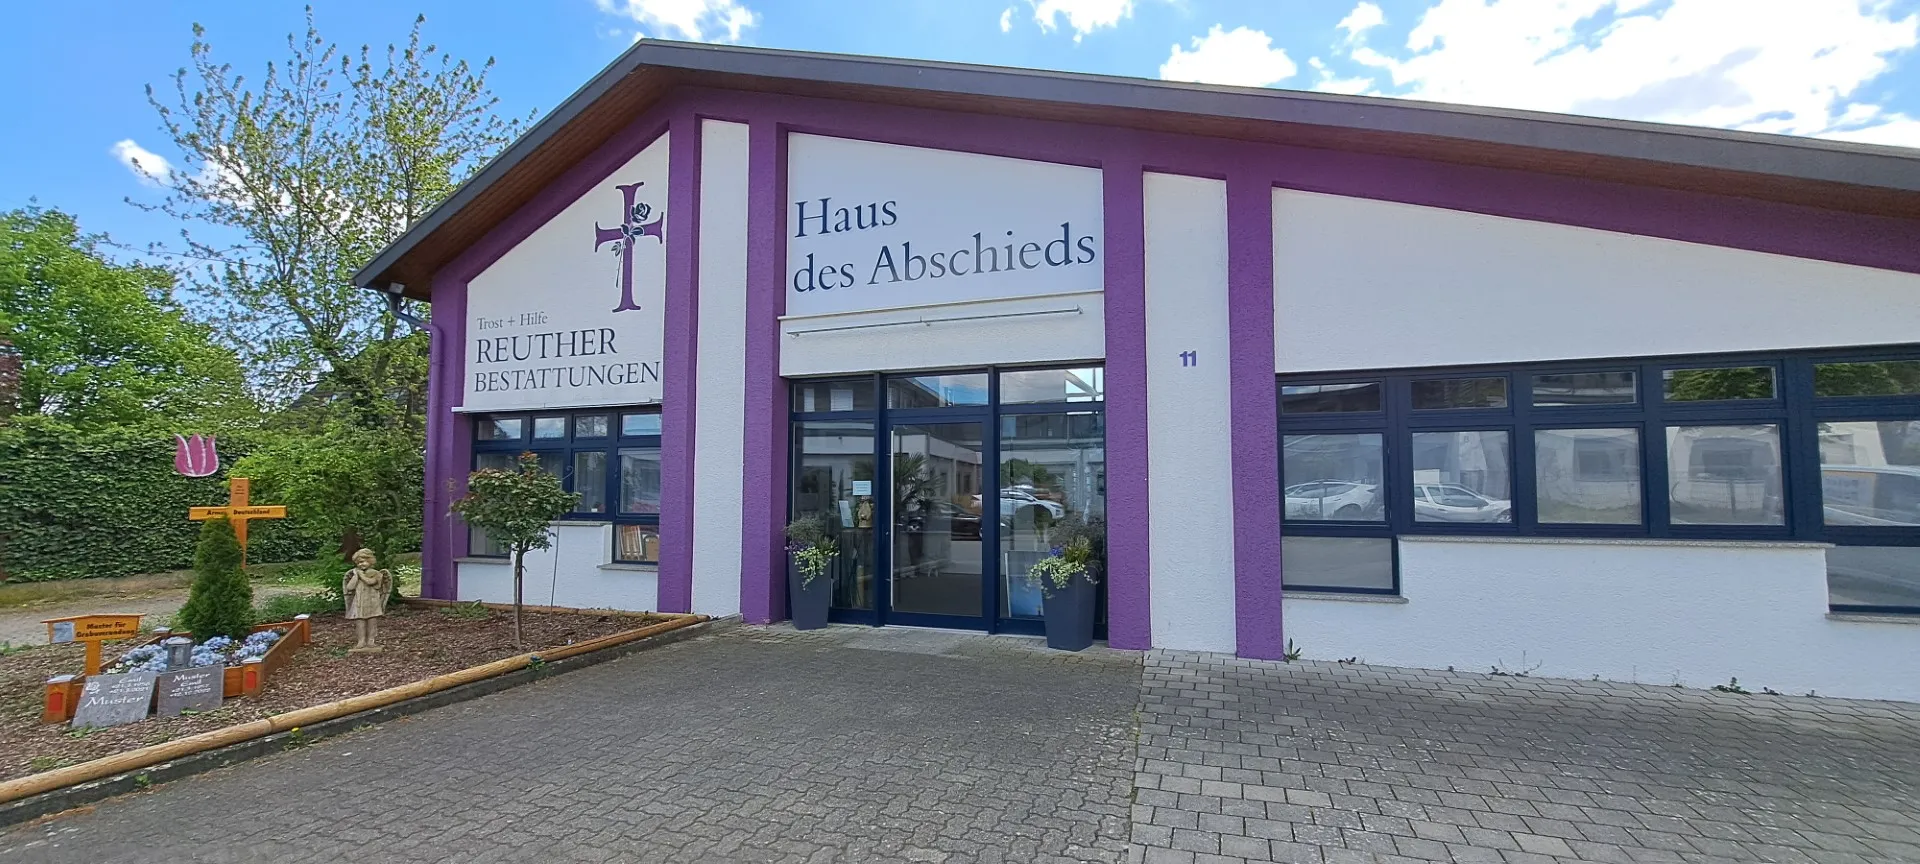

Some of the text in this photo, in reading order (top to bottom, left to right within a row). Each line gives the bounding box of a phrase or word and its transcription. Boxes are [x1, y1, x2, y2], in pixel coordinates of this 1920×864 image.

[794, 197, 897, 238] Haus
[793, 222, 1096, 293] des Abschieds
[477, 317, 503, 330] Trost
[520, 311, 548, 327] Hilfe
[476, 328, 618, 363] REUTHER
[1179, 350, 1197, 367] 11
[475, 361, 660, 392] BESTATTUNGEN
[173, 673, 211, 682] Muster
[84, 696, 144, 708] Muster
